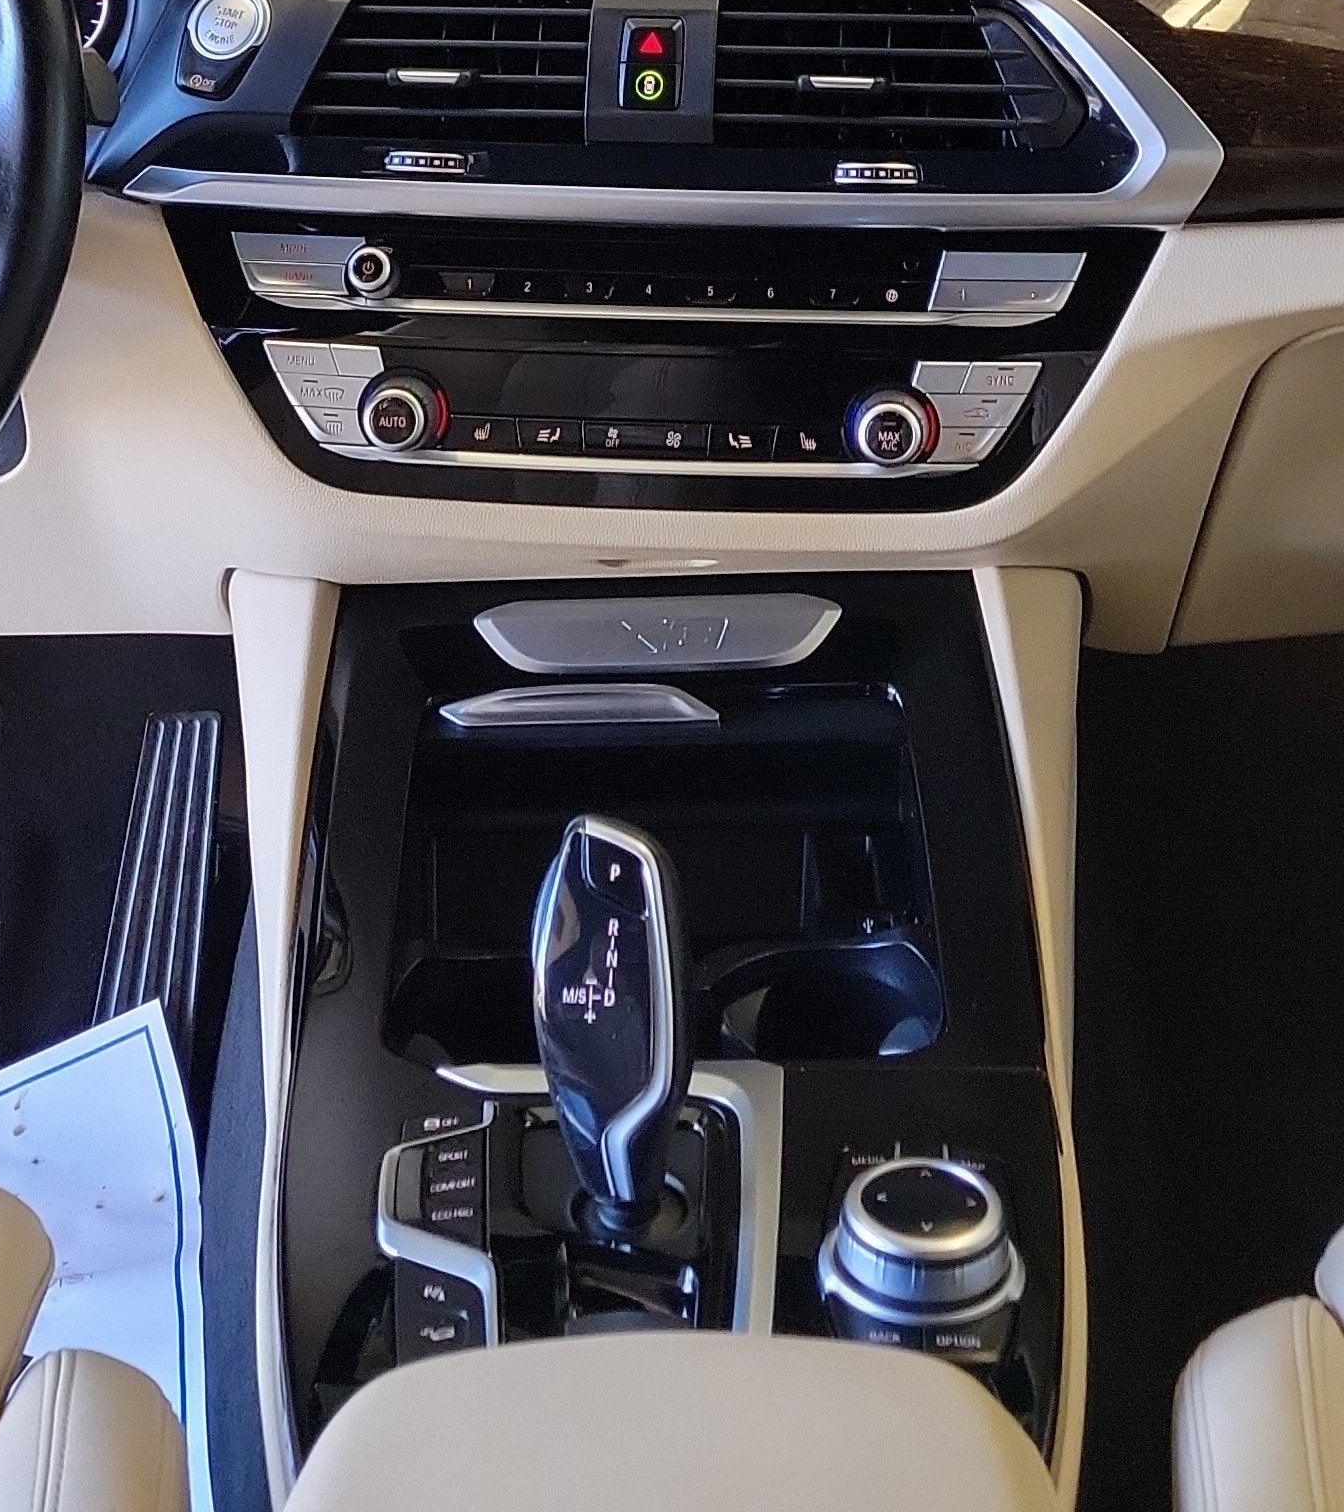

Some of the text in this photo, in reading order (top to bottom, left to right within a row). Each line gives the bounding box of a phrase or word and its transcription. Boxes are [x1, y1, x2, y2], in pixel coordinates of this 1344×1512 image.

[217, 5, 245, 20] START
[213, 17, 239, 30] STOP
[204, 29, 236, 45] ENGINE
[467, 278, 473, 290] 1
[524, 281, 532, 293] 2
[586, 281, 593, 294] 3
[645, 284, 652, 295] 4
[707, 285, 714, 297] 5
[767, 287, 774, 299] 6
[829, 288, 836, 300] 7
[286, 355, 316, 366] MENU
[986, 375, 1016, 387] SYNC
[300, 387, 323, 398] MAX
[378, 416, 406, 428] AUTO
[878, 430, 900, 442] MAX
[605, 438, 620, 448] OFF
[880, 440, 898, 451] A/C
[609, 863, 621, 883] P
[607, 917, 619, 937] R
[606, 948, 618, 968] N
[604, 988, 616, 1008] D
